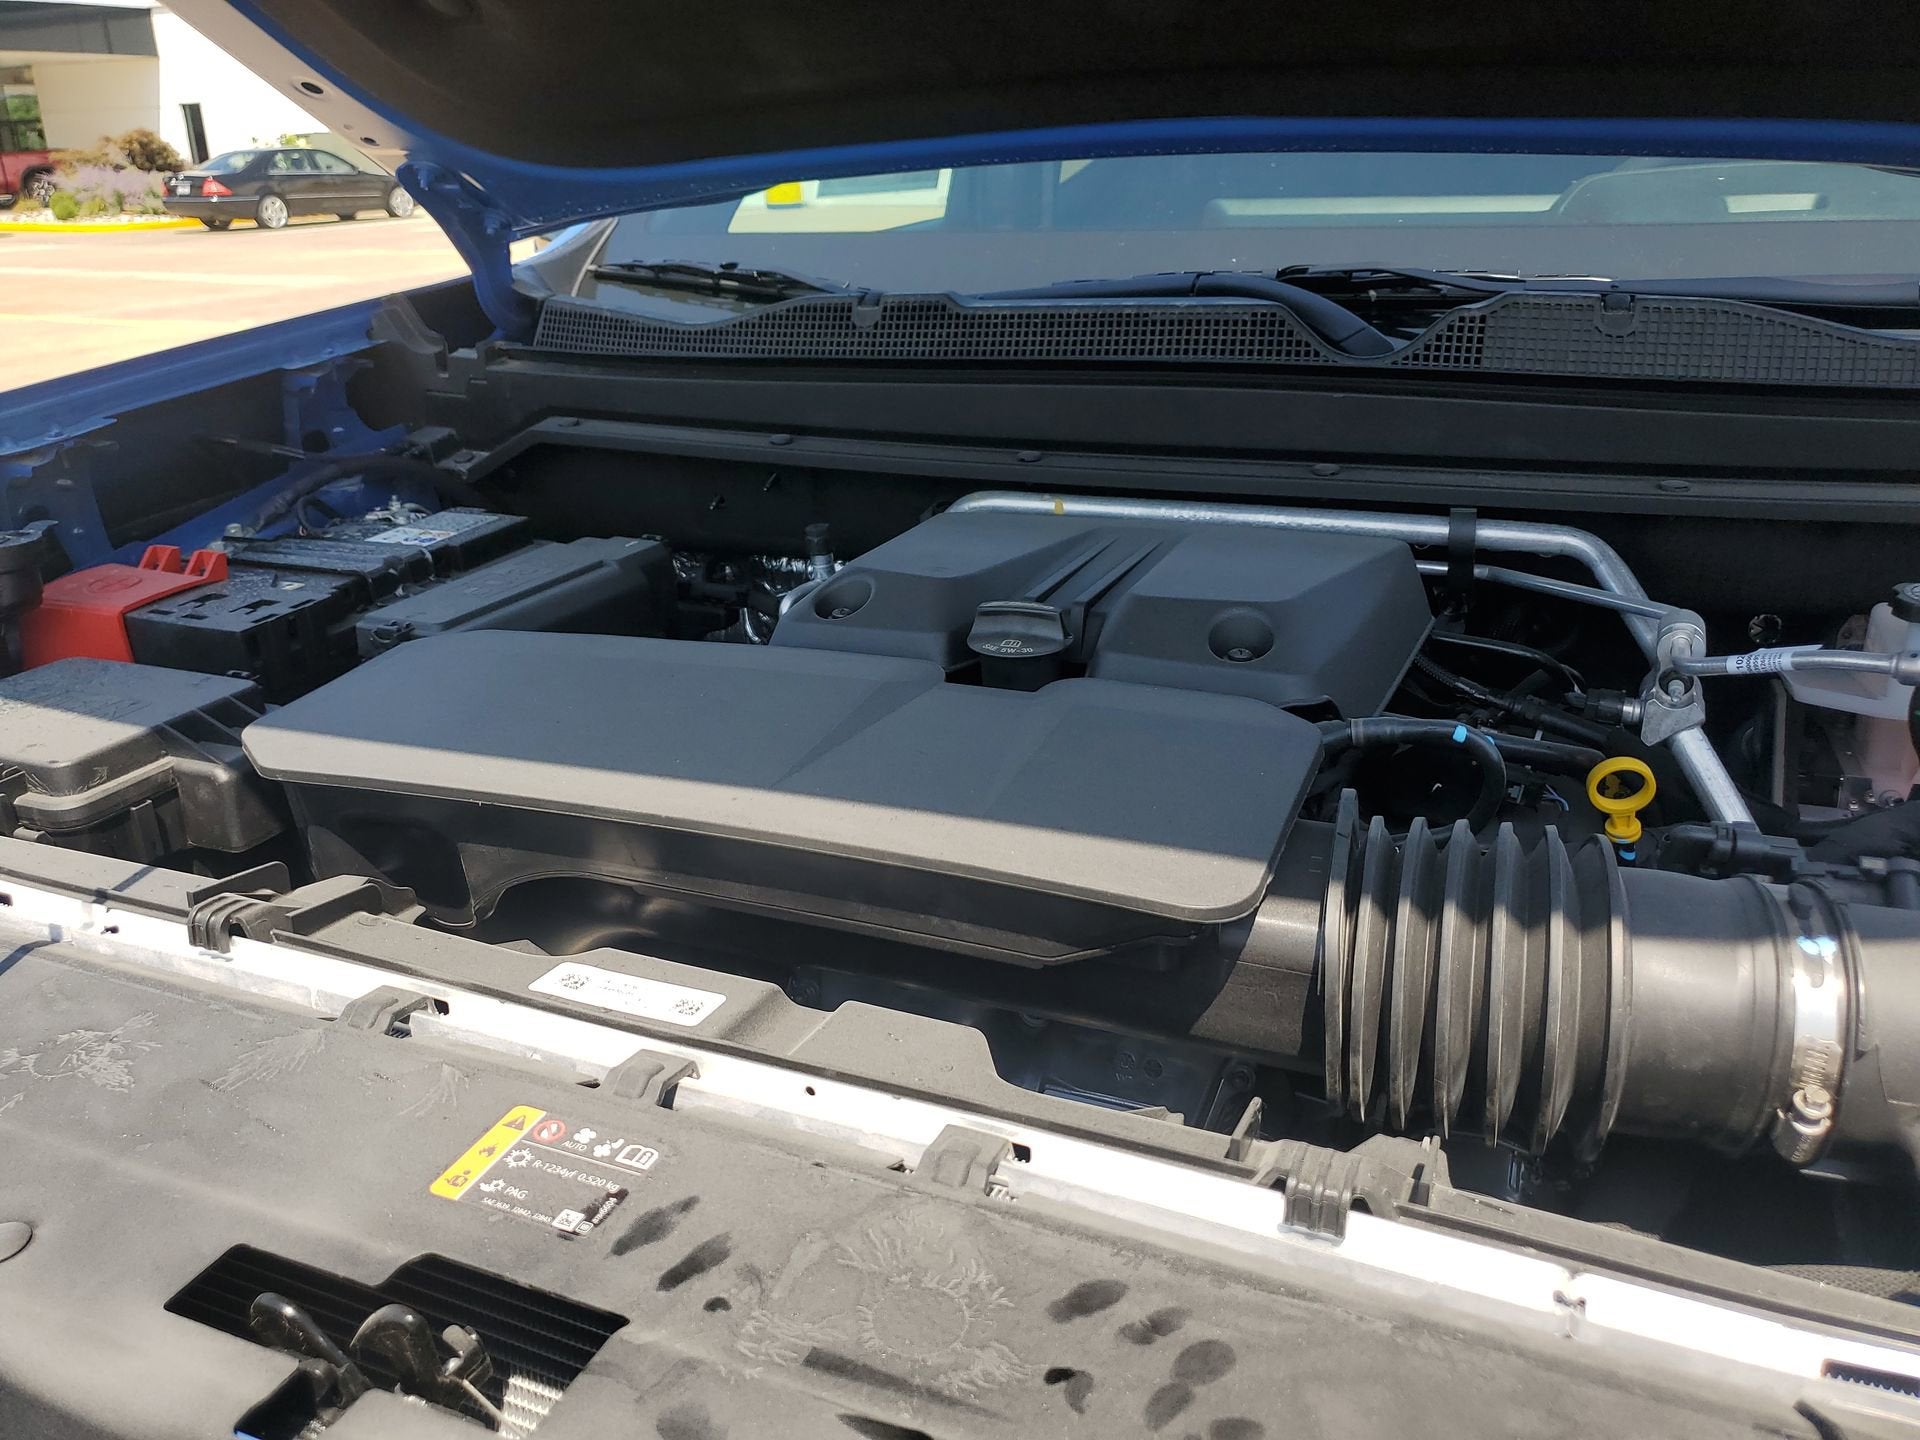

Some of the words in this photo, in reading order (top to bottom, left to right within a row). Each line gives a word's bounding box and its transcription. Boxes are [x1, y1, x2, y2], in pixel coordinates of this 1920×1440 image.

[561, 1140, 588, 1151] AUTO
[531, 1159, 579, 1180] R-1234yf
[577, 1173, 607, 1187] 0.520
[606, 1180, 620, 1194] kg
[503, 1185, 529, 1200] PAG
